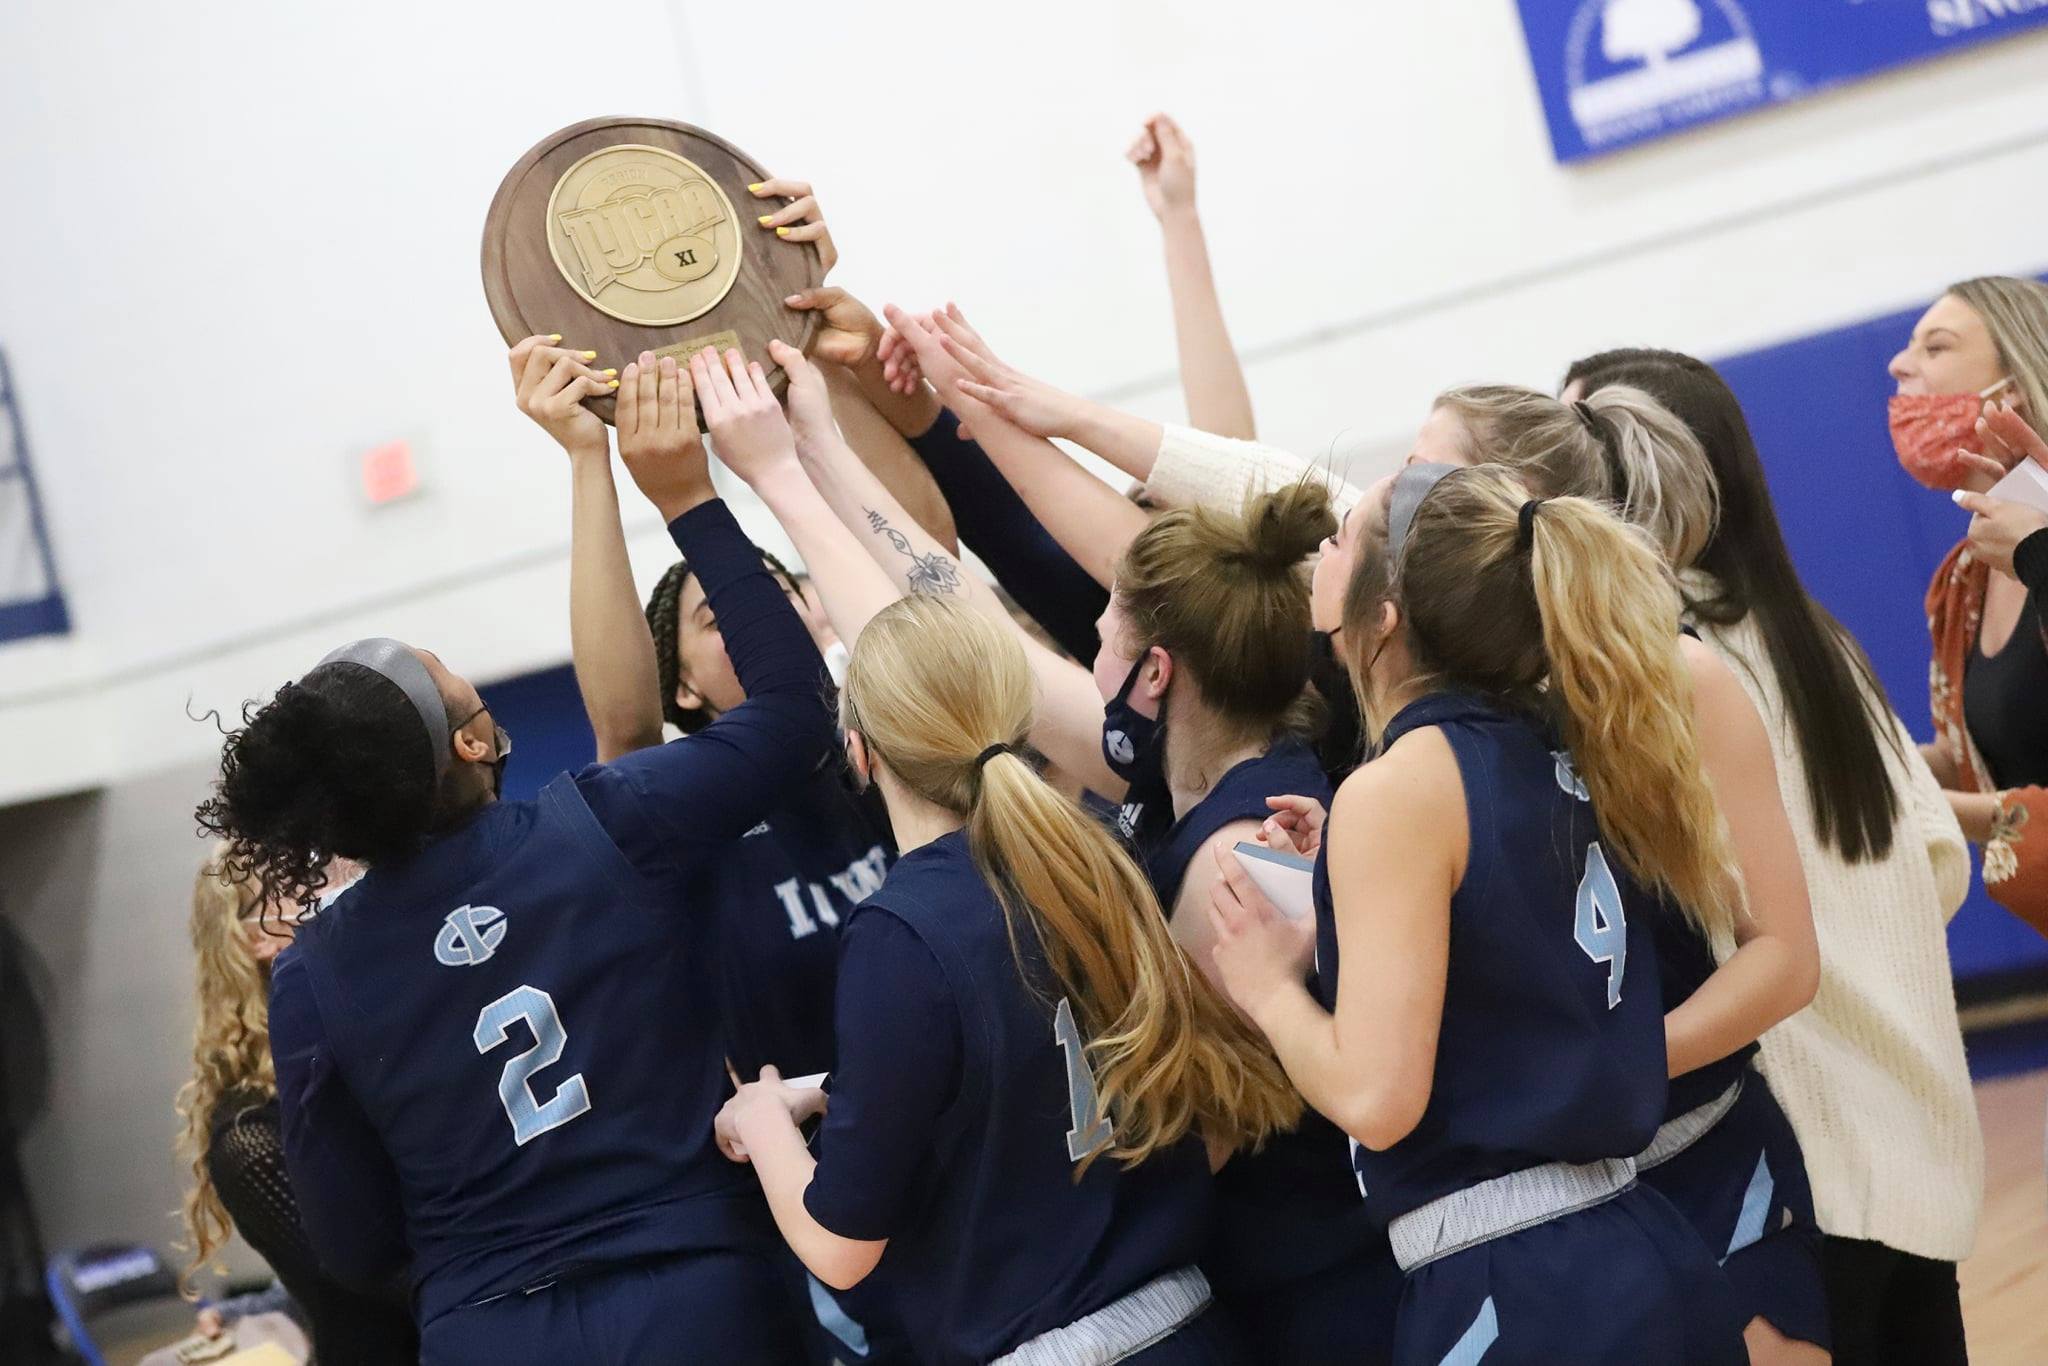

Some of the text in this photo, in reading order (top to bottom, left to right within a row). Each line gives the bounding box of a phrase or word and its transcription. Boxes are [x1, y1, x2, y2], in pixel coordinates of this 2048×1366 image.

[558, 180, 726, 298] NJCAA
[674, 250, 698, 268] XI
[1574, 840, 1627, 1010] 4
[473, 984, 592, 1147] 2
